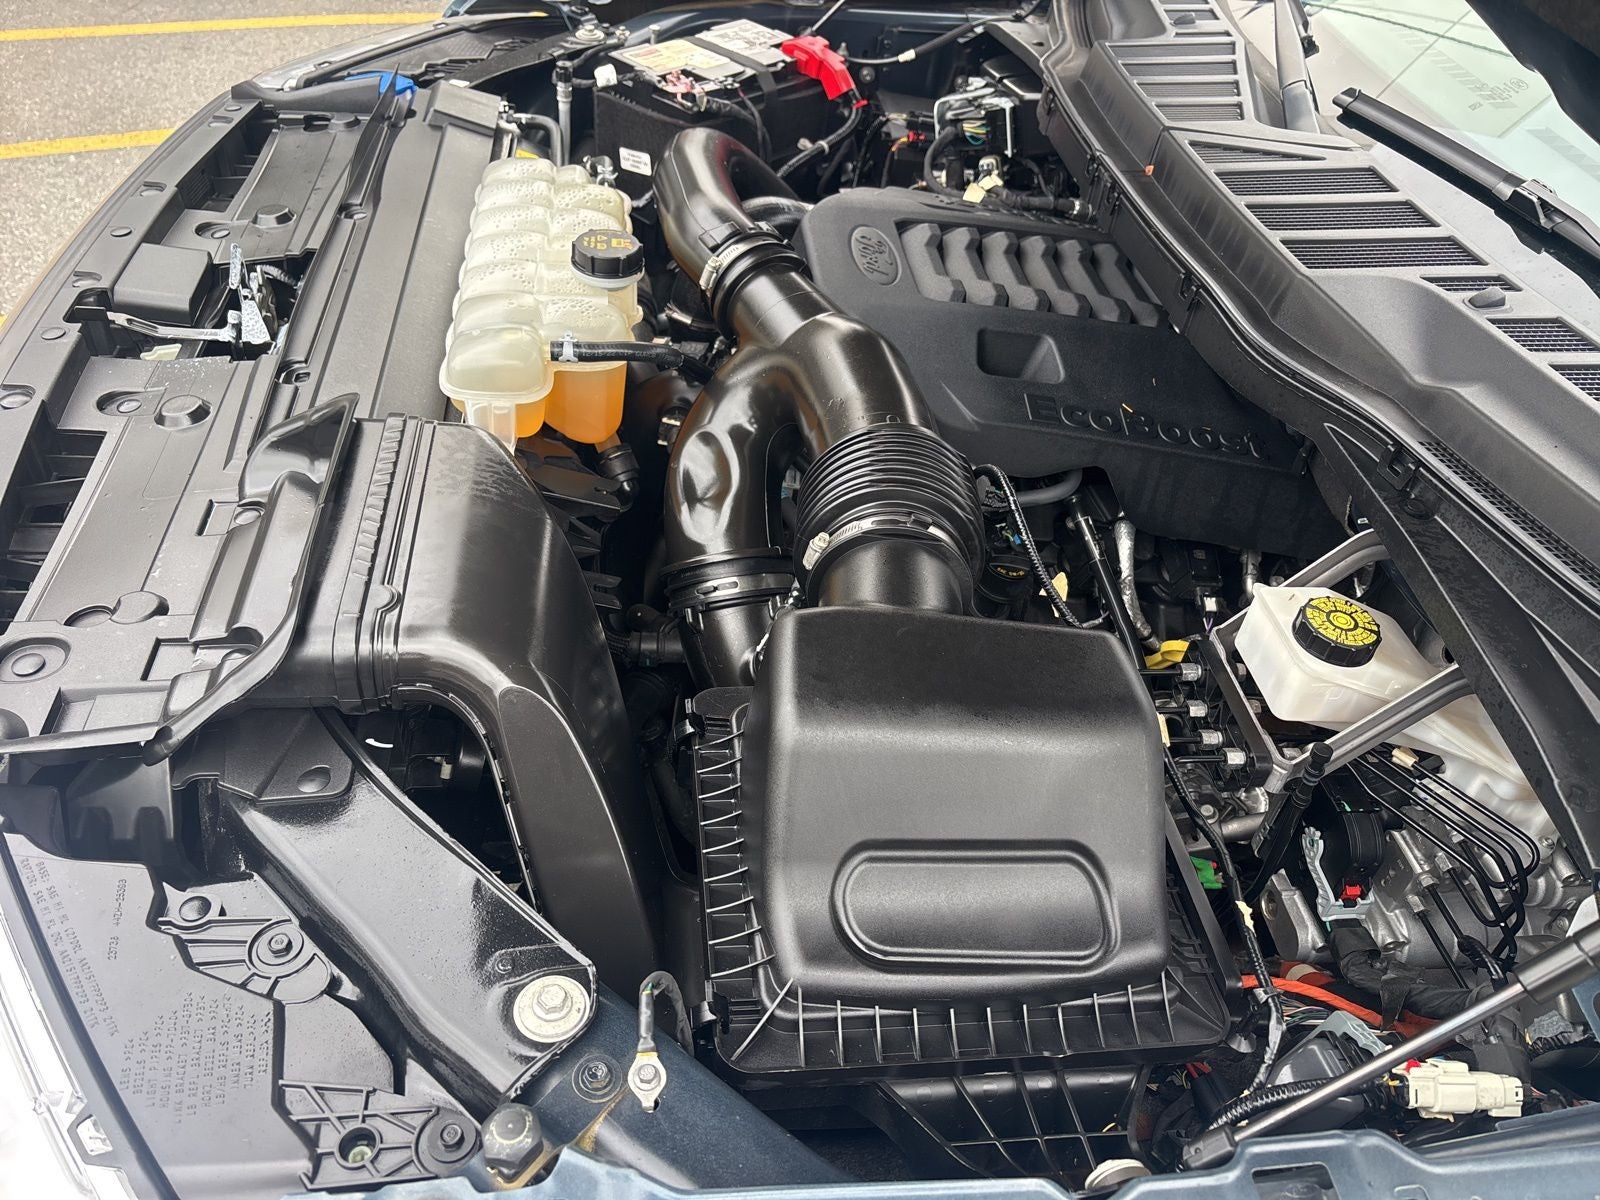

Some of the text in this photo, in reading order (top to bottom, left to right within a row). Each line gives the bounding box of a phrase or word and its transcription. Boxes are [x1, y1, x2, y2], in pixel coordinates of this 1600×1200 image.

[855, 235, 894, 276] Ford
[1024, 393, 1268, 461] EcoBoost
[32, 889, 46, 904] SAE
[45, 884, 59, 900] SAE
[190, 1028, 203, 1068] BRACKET
[174, 1053, 187, 1094] BRACKET
